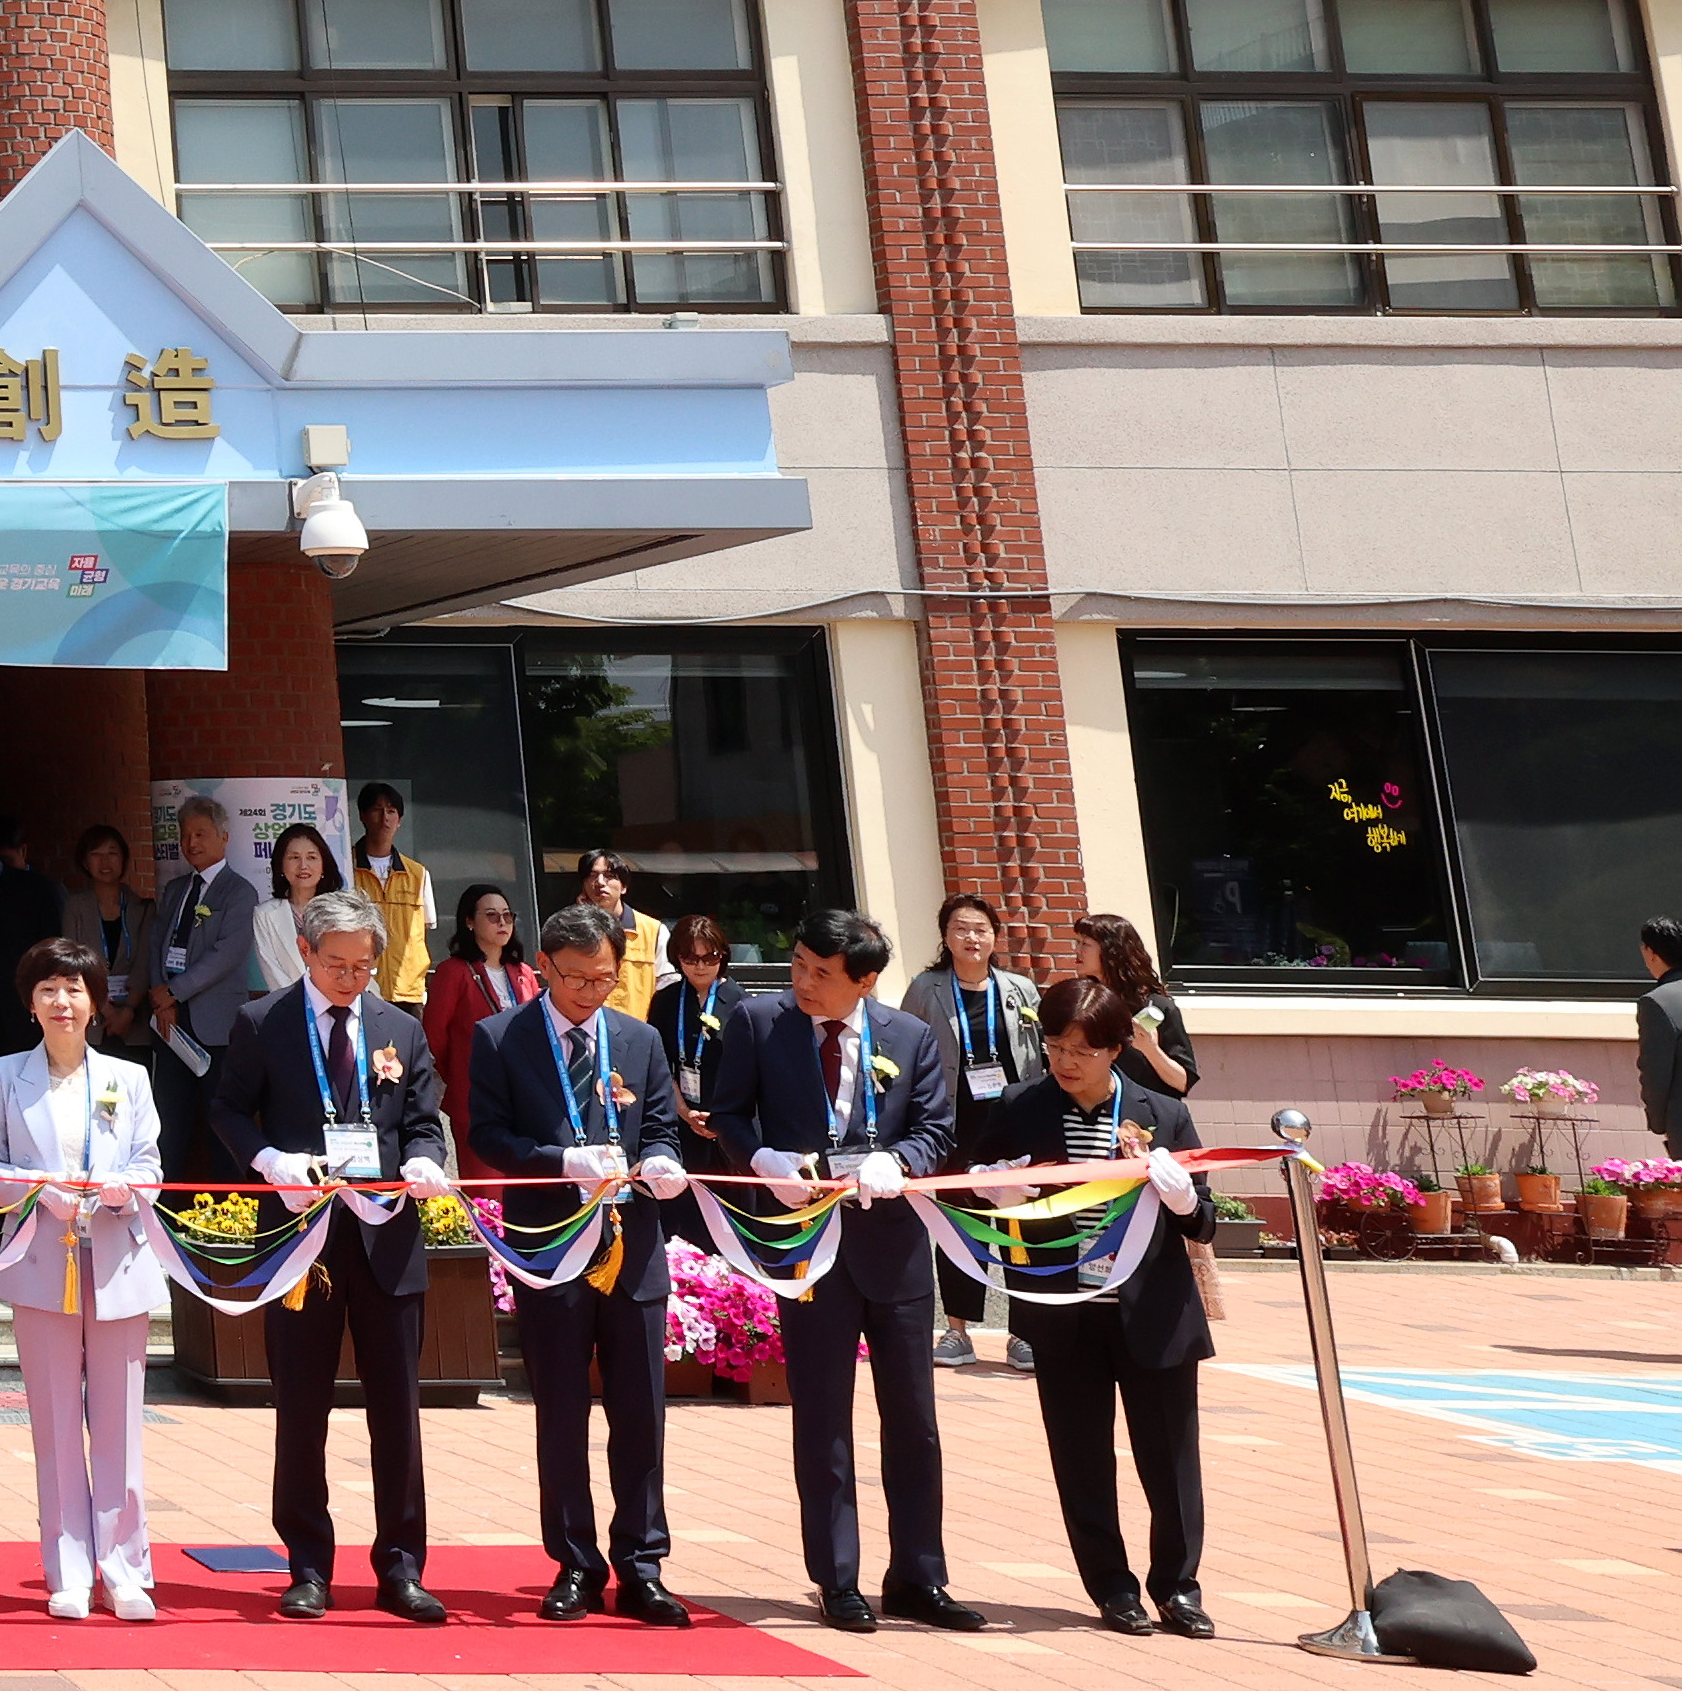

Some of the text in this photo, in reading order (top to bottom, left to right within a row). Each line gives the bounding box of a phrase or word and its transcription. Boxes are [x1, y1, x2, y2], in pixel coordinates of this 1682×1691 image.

[10, 578, 61, 591] 경기교육
[69, 584, 94, 597] 미래
[270, 802, 318, 821] 경기도
